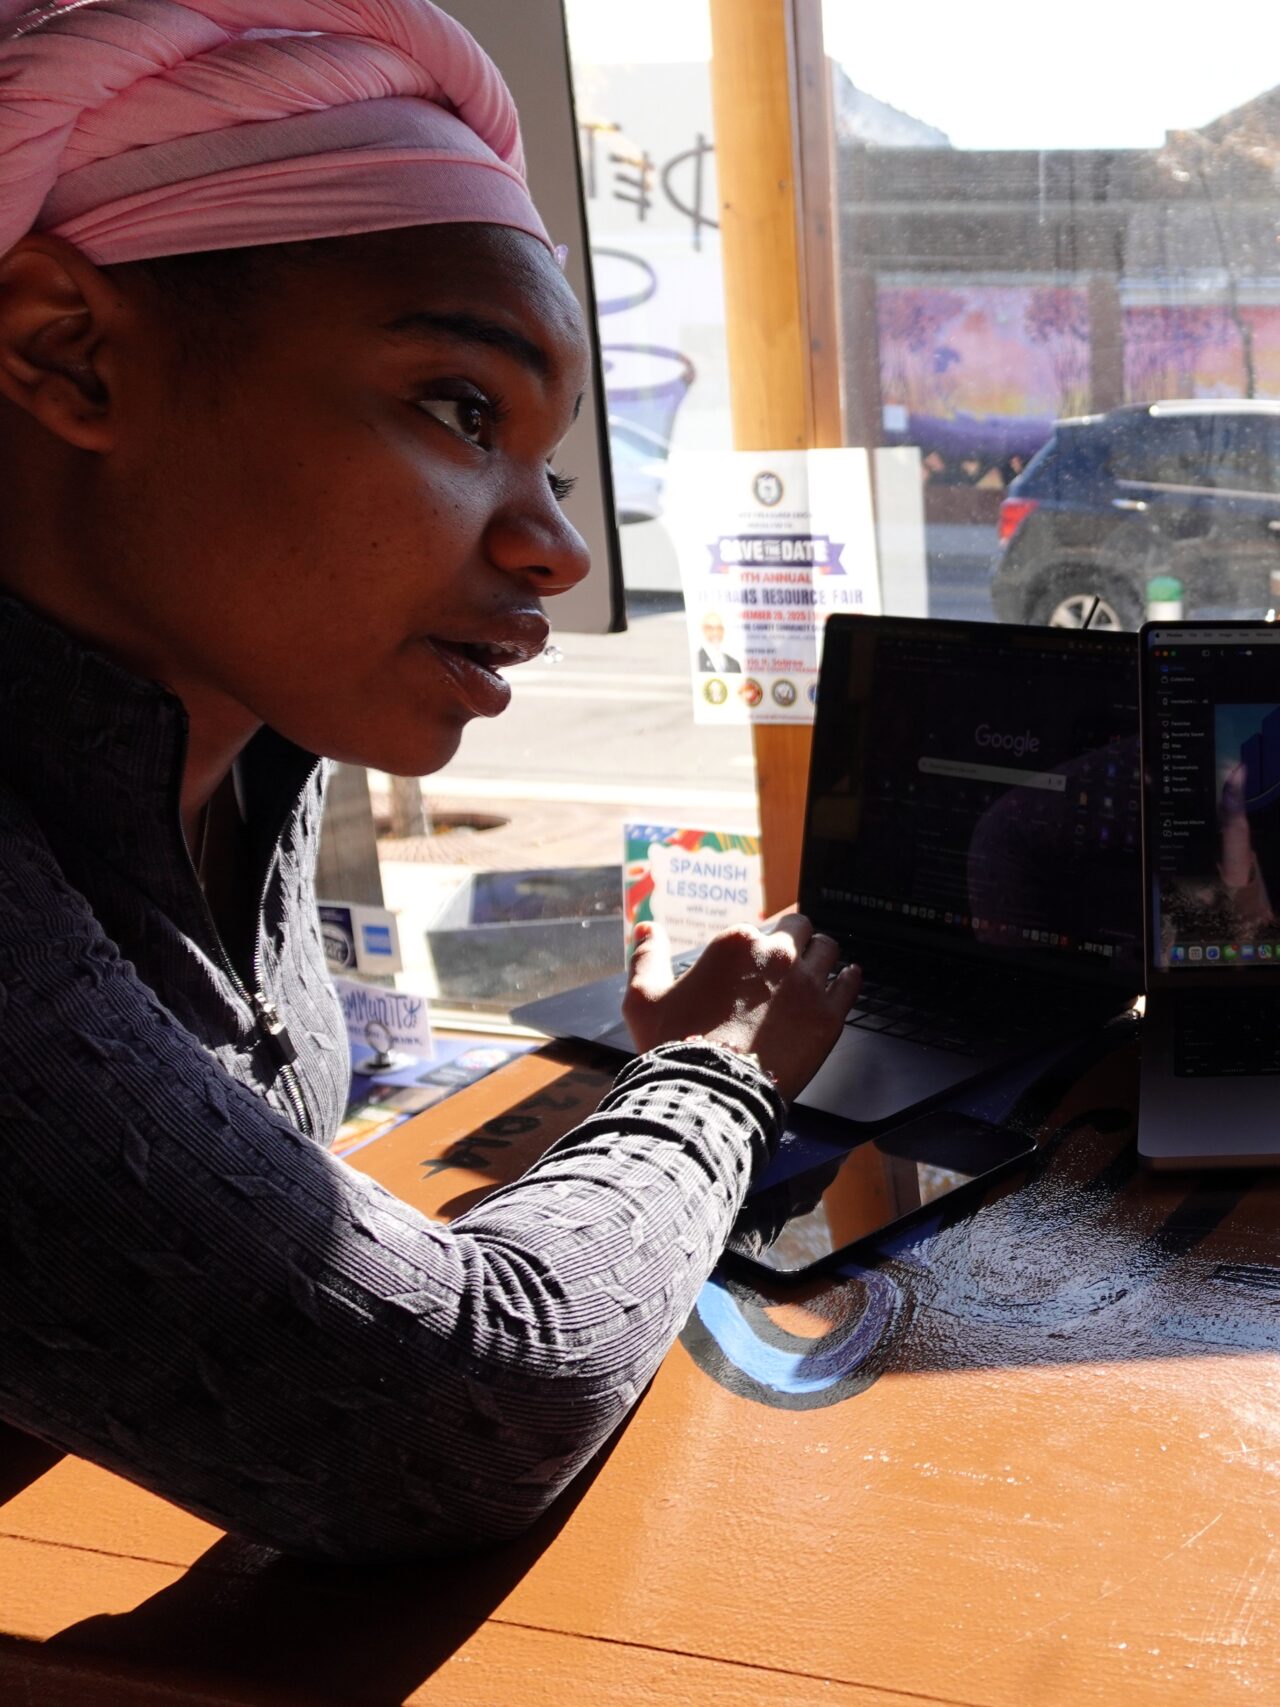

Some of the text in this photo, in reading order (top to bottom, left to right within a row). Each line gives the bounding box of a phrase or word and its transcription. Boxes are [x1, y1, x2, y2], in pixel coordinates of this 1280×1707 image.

[781, 540, 827, 562] DATE
[761, 587, 827, 607] RESOURCE
[833, 589, 863, 604] FAIR
[974, 723, 1041, 758] Google
[669, 856, 748, 882] SPANISH
[665, 879, 749, 907] LESSONS
